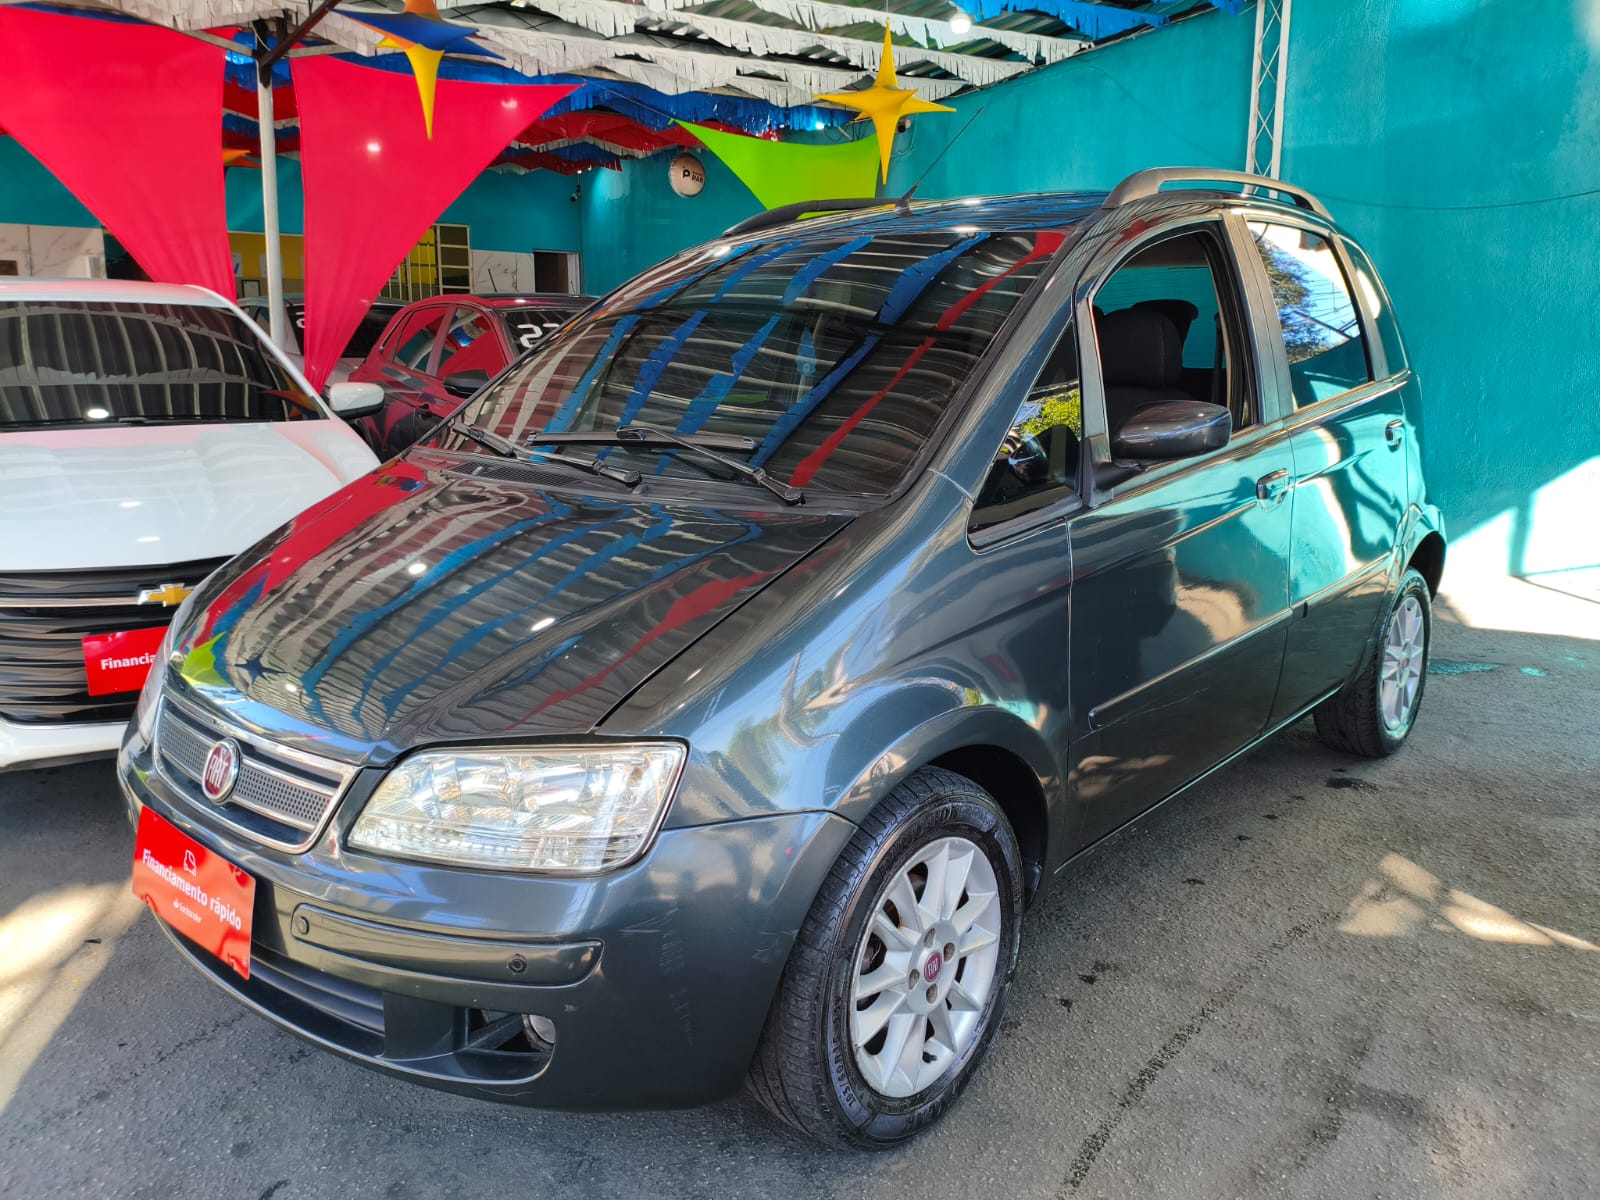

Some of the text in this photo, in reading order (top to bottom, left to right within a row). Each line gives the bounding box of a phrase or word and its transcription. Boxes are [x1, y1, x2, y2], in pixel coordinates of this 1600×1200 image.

[206, 747, 229, 789] FIAT
[142, 848, 242, 931] Financiamento rápido
